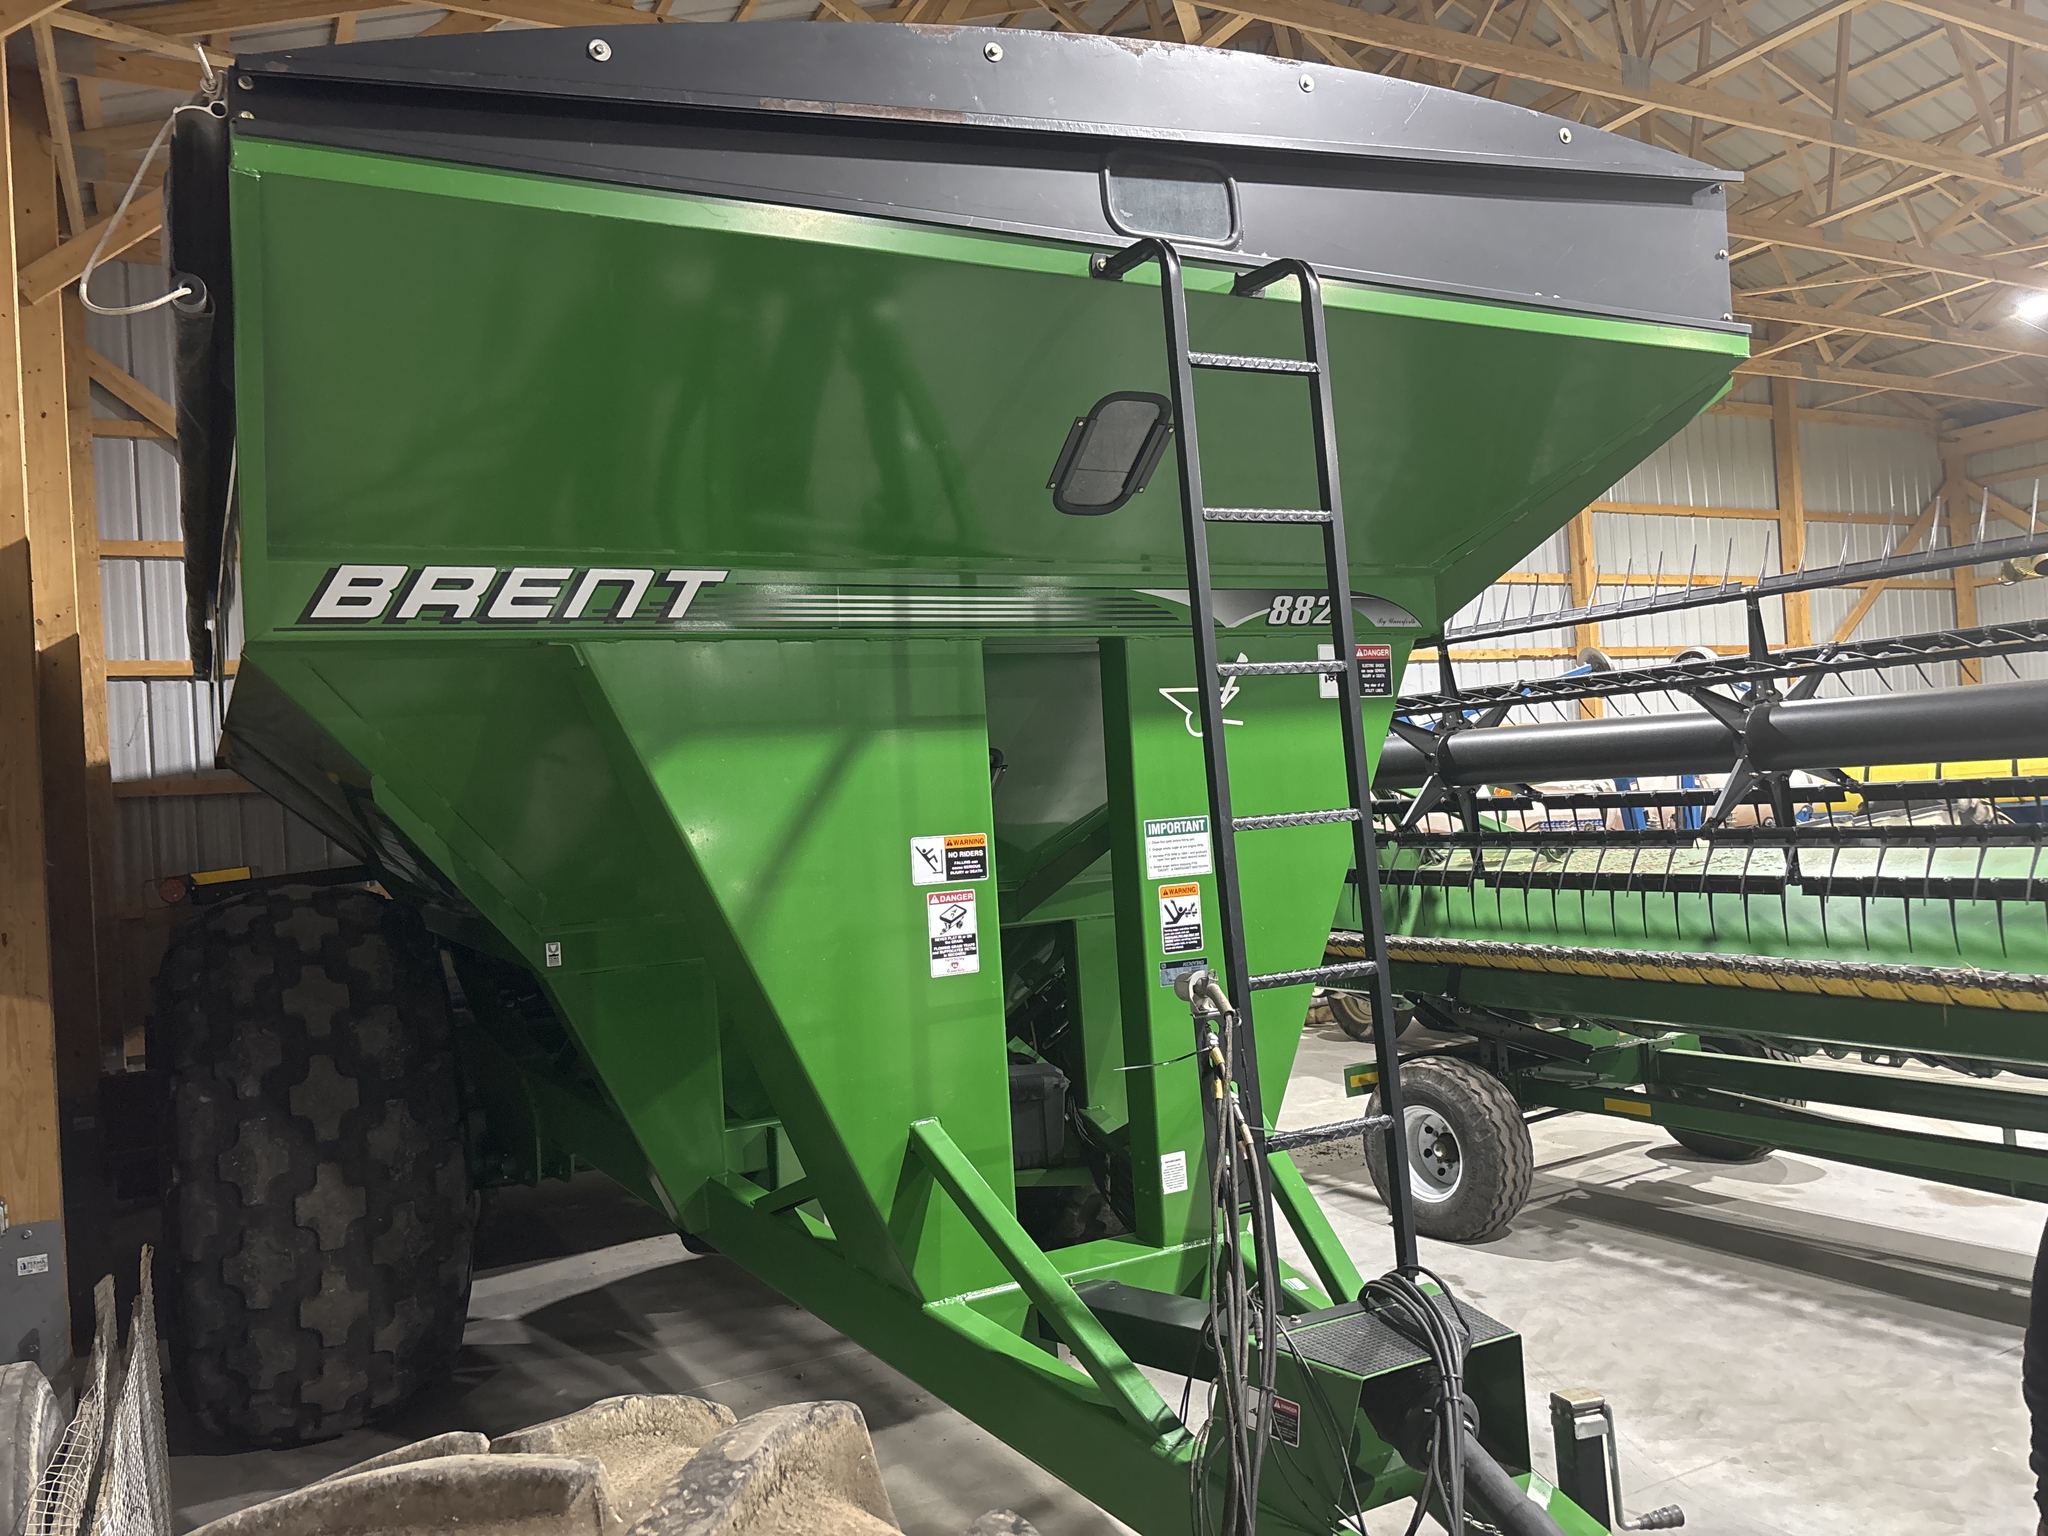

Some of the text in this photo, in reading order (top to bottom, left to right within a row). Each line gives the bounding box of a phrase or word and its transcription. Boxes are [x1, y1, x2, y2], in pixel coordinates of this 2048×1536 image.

[308, 564, 730, 619] BRENT
[1268, 596, 1332, 625] 882
[1363, 648, 1390, 657] DANGER
[1148, 820, 1206, 836] IMPORTANT
[952, 838, 985, 846] WARNING
[959, 849, 984, 858] RIDERS
[1168, 886, 1196, 895] WARNING
[940, 892, 974, 903] DANGER
[1280, 1404, 1297, 1413] DANGER
